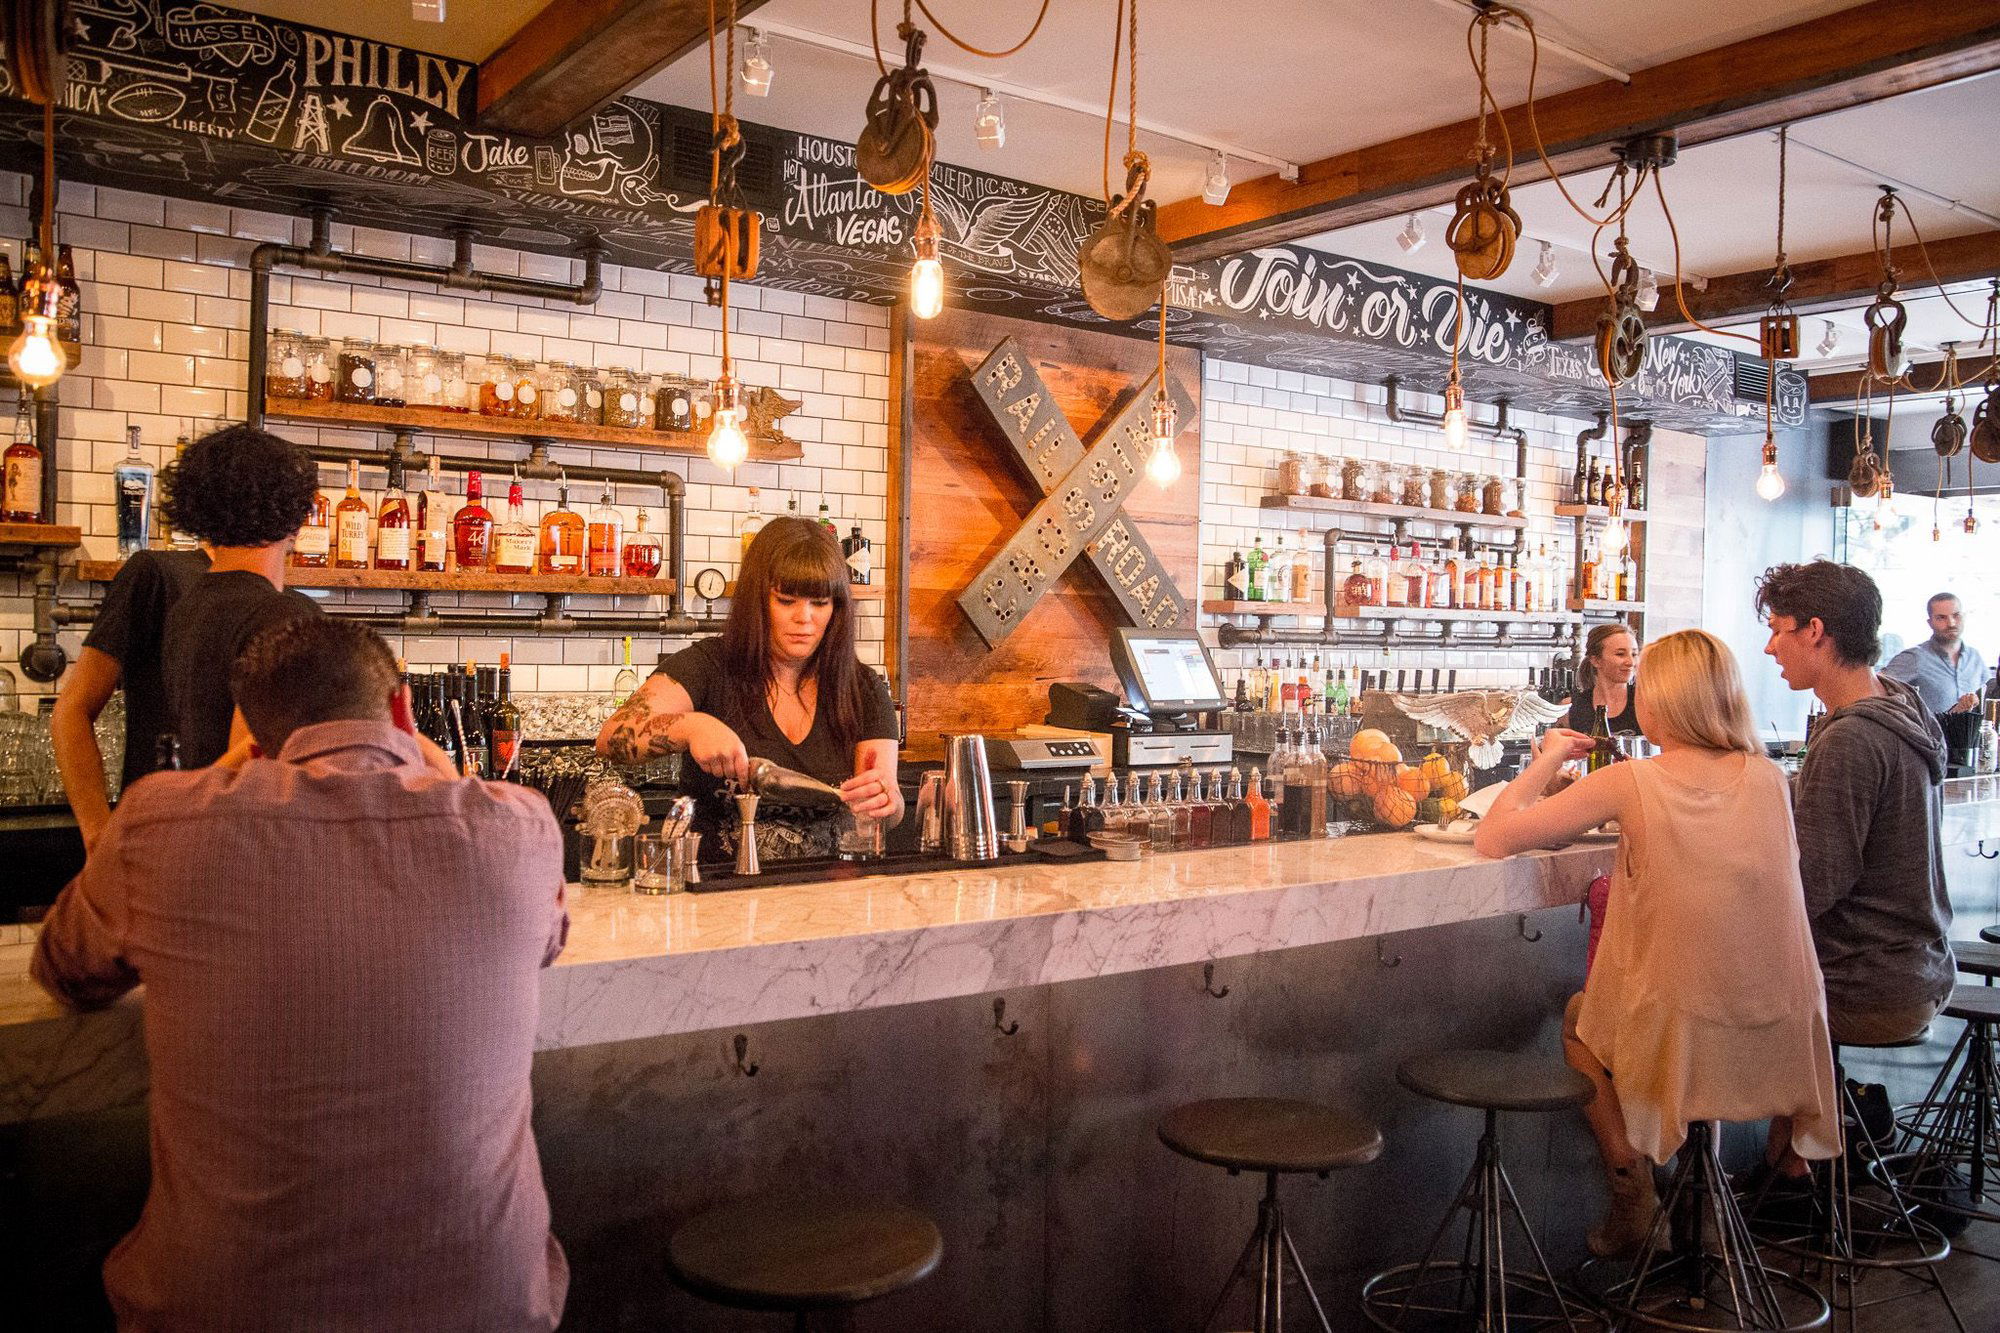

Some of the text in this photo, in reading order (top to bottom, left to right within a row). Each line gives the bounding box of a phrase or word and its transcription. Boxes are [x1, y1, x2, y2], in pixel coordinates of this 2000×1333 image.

[178, 25, 269, 45] HASSEL
[302, 31, 472, 119] PHILLY
[172, 118, 236, 138] LIBERTY
[429, 147, 456, 161] BEER
[461, 131, 529, 173] Jake
[783, 159, 802, 181] HOT
[785, 168, 882, 231] Atlanta
[836, 213, 903, 246] VEGAS
[959, 250, 975, 262] THE
[977, 255, 1010, 268] BRAVE
[1219, 248, 1512, 366] Join or Die
[1646, 337, 1684, 374] New
[1668, 362, 1700, 403] York
[985, 352, 1065, 478] RAIL
[1096, 517, 1181, 630] ROAD
[467, 530, 486, 547] 46
